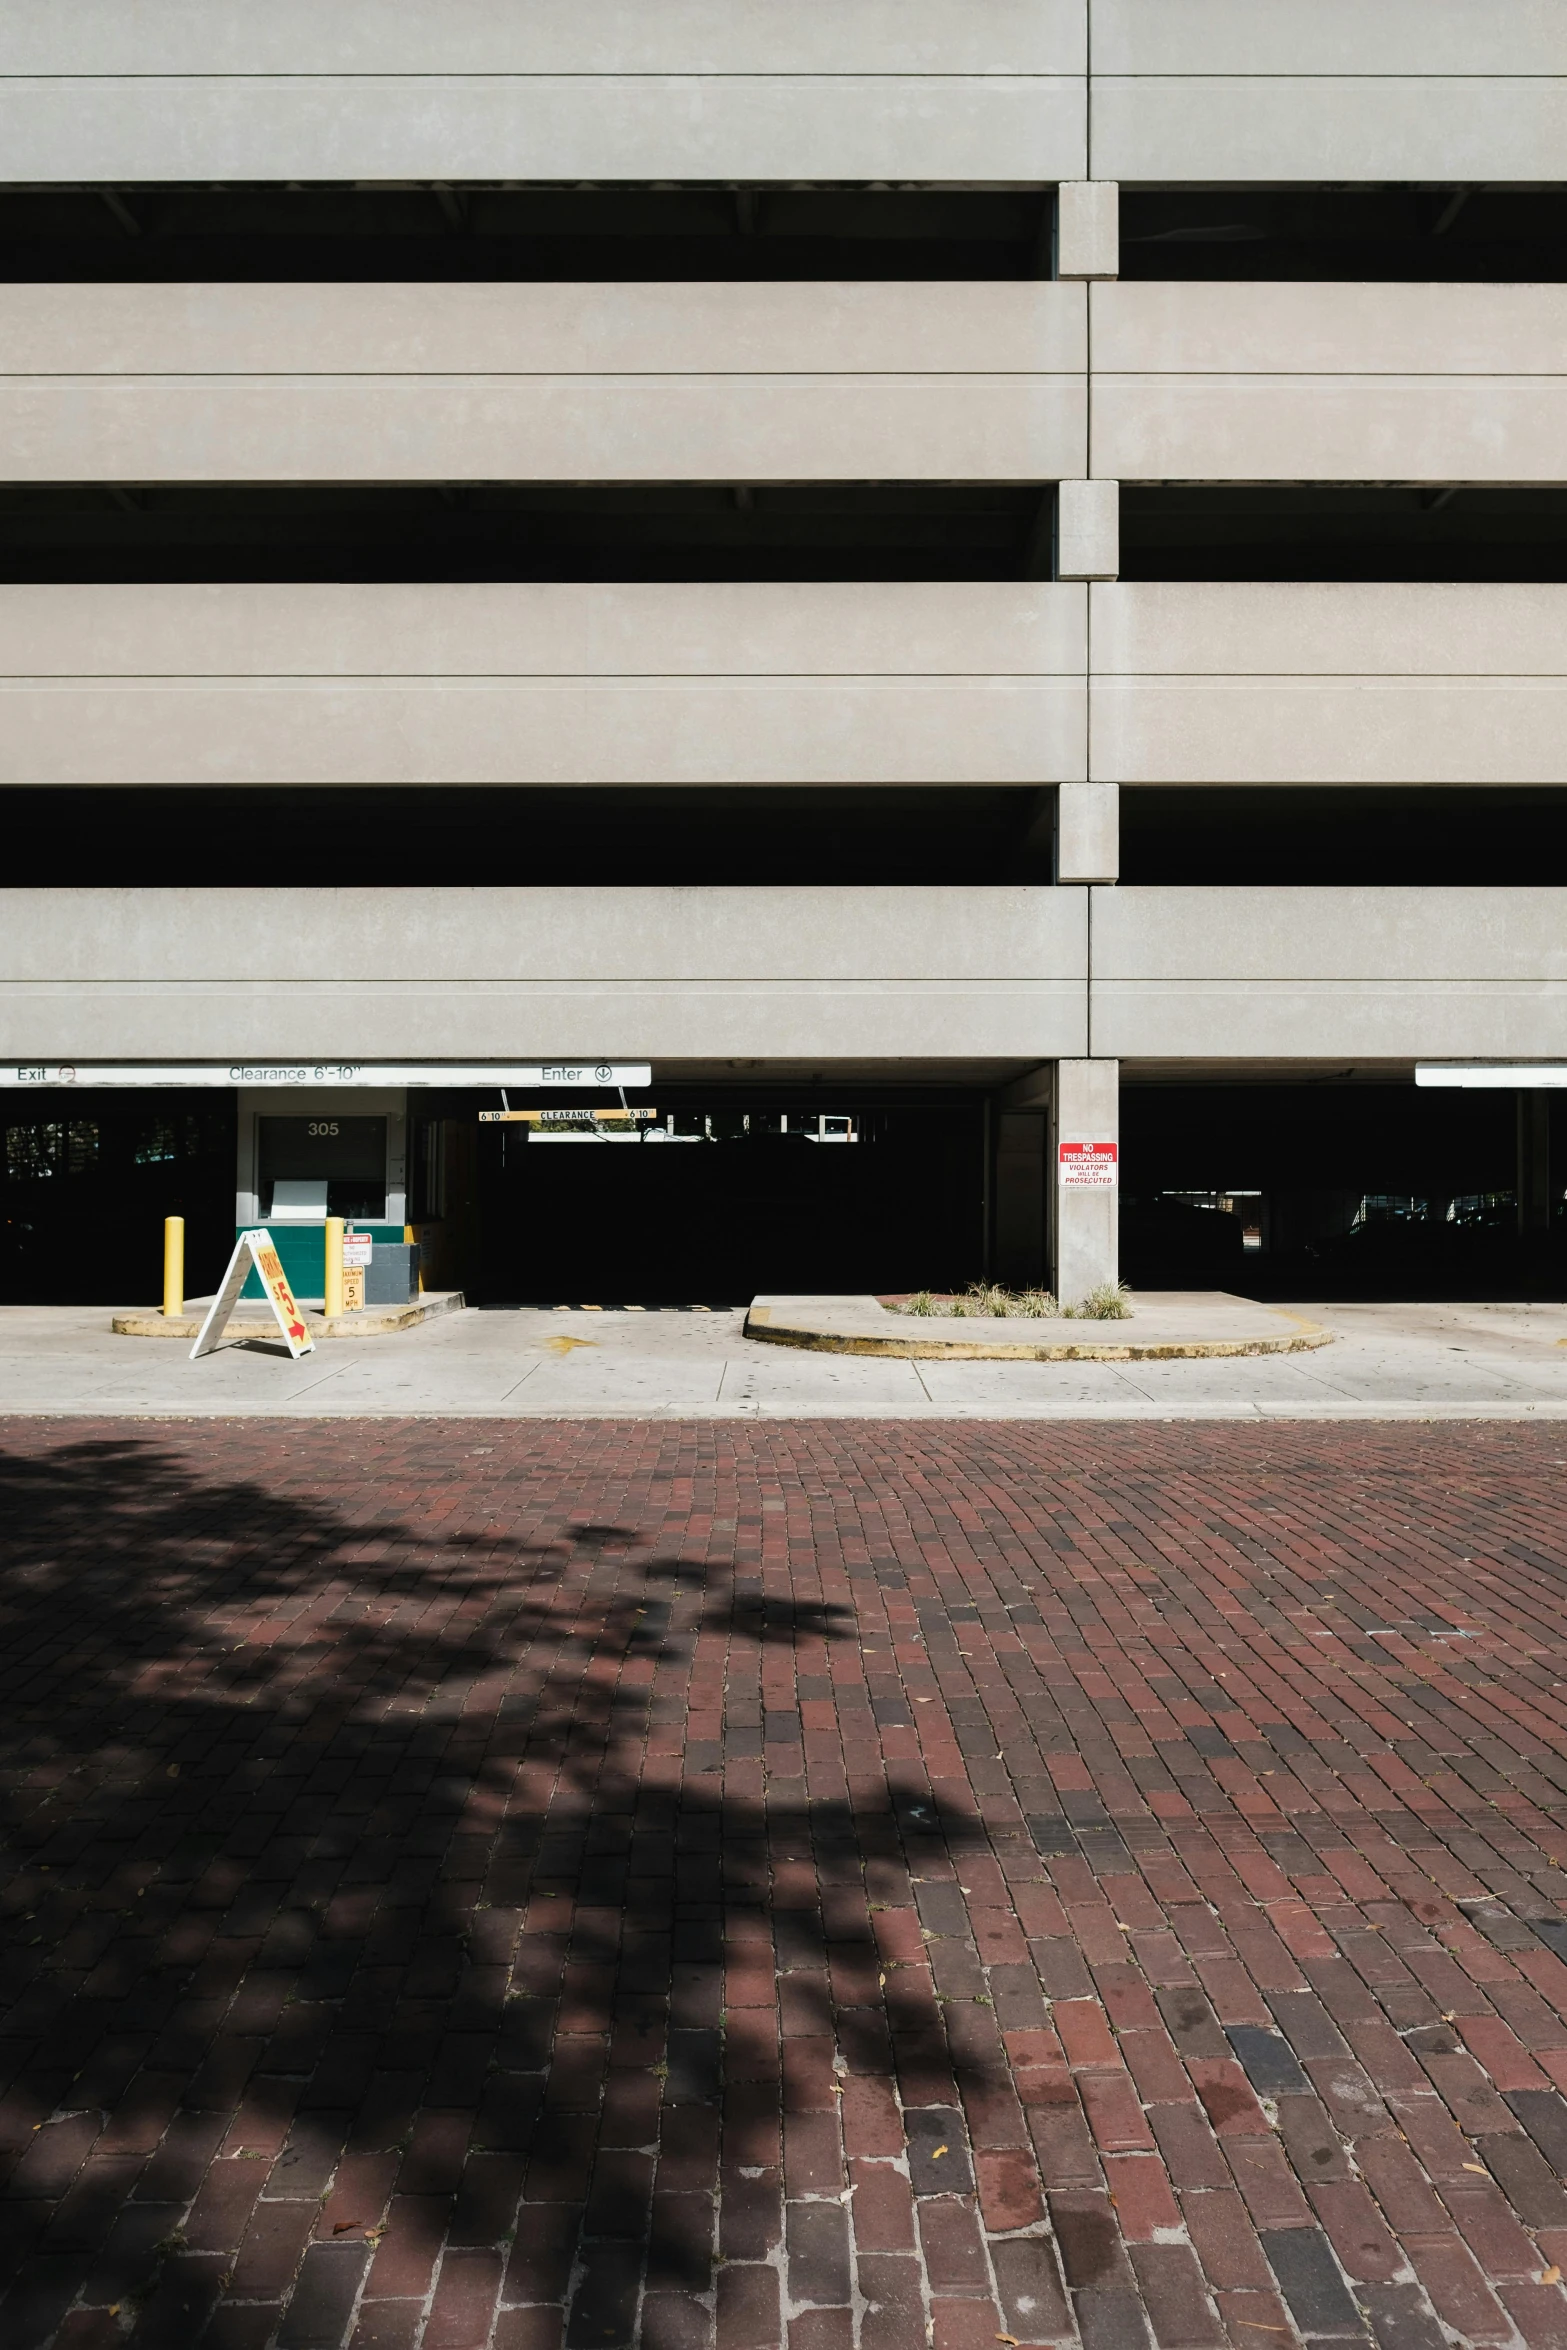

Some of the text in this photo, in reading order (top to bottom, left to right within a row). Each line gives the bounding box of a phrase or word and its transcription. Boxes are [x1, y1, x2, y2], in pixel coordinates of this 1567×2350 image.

[17, 1067, 47, 1081] Exit
[229, 1066, 306, 1080] Clearance
[541, 1066, 583, 1081] Enter
[540, 1110, 595, 1119] CLEARANCE
[308, 1122, 339, 1136] 305
[1082, 1143, 1094, 1152] NO
[1063, 1152, 1113, 1162] TRESPASSING
[348, 1286, 355, 1298] 5
[345, 1299, 358, 1307] MPH
